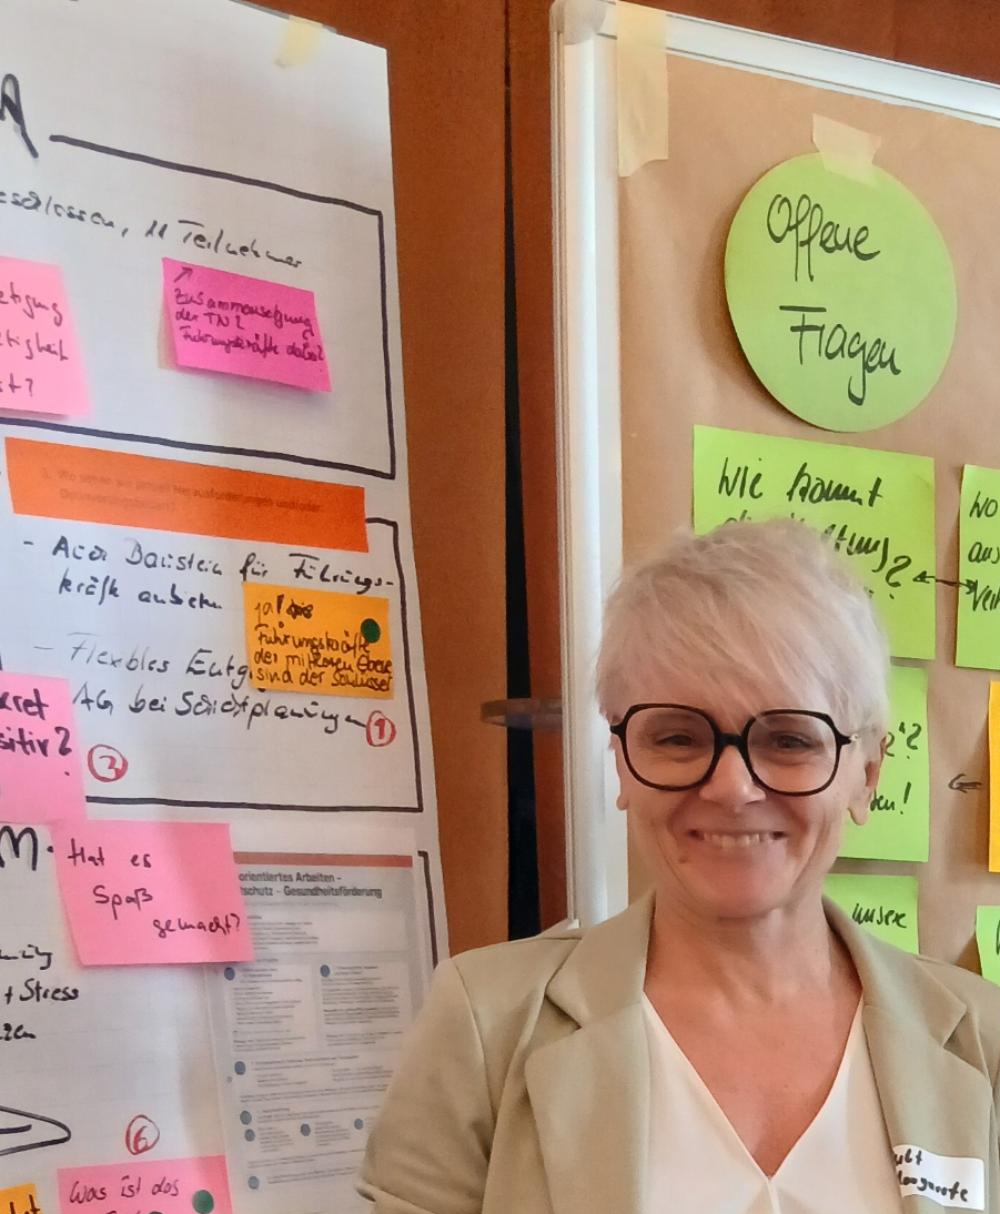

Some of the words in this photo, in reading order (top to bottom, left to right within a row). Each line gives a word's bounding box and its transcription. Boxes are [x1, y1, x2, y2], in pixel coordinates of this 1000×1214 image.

[178, 219, 302, 269] Teilnehmer
[767, 193, 880, 281] Offene
[779, 305, 901, 406] Fragen
[718, 457, 763, 499] Wie
[125, 537, 223, 576] Baustein
[240, 553, 268, 582] für
[289, 553, 394, 595] Führungs-
[968, 541, 1000, 564] aus
[58, 569, 119, 606] kräfte
[138, 584, 223, 609] anbieten
[255, 621, 370, 658] Führungskräfte
[253, 648, 278, 664] der
[256, 667, 293, 684] sind
[299, 668, 325, 686] der
[128, 683, 168, 713] bei
[68, 838, 105, 866] Hat
[130, 853, 152, 868] es
[295, 872, 335, 883] Arbeiten
[93, 884, 153, 920] Spaß
[852, 903, 908, 929] unsere
[19, 978, 79, 1003] Stress
[69, 1180, 107, 1204] Was
[121, 1175, 141, 1197] ist
[152, 1177, 179, 1197] das
